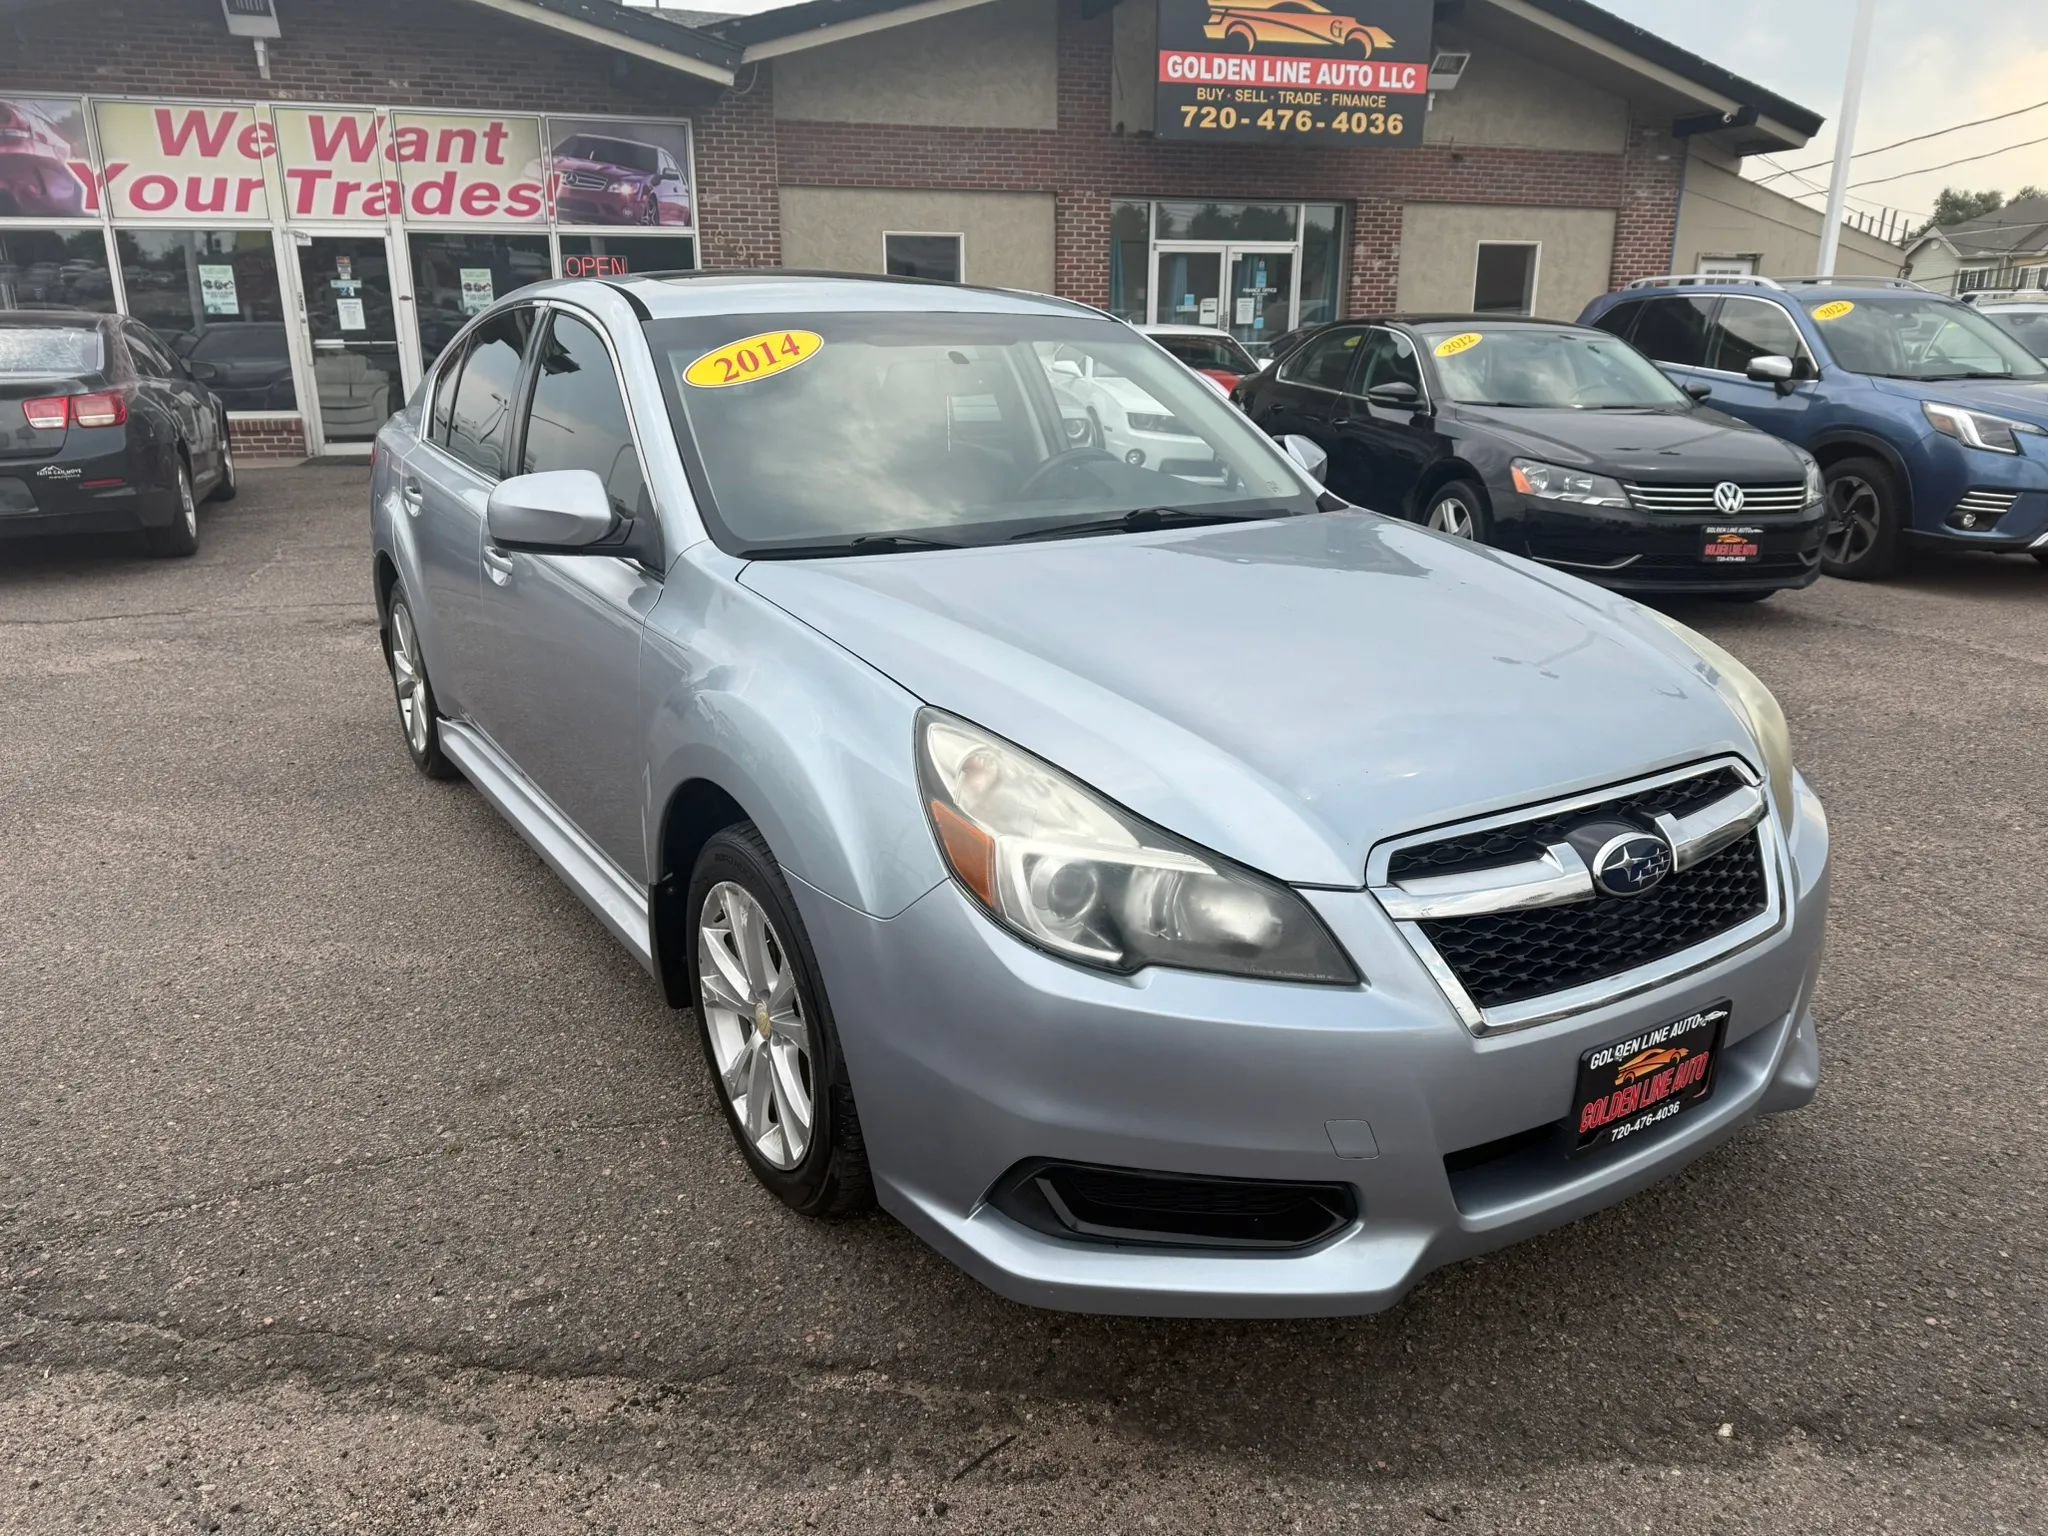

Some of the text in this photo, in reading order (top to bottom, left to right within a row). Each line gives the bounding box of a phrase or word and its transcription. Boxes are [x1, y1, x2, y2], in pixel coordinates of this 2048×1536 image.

[1167, 55, 1416, 90] GOLDEN LINE AUTO LLC
[1197, 87, 1387, 108] BUY SELL TRADE FINANCE
[154, 108, 509, 166] We Want
[67, 162, 562, 218] Your Trades!
[566, 256, 625, 278] OPEN
[1820, 303, 1848, 317] 2022
[713, 333, 801, 383] 2014
[1443, 334, 1475, 353] 2012
[1590, 1013, 1701, 1070] GOLDEN LINE AUTO
[1579, 1051, 1709, 1133] GOLDEN LINE AUTO
[1611, 1101, 1680, 1142] 720-476-4036
